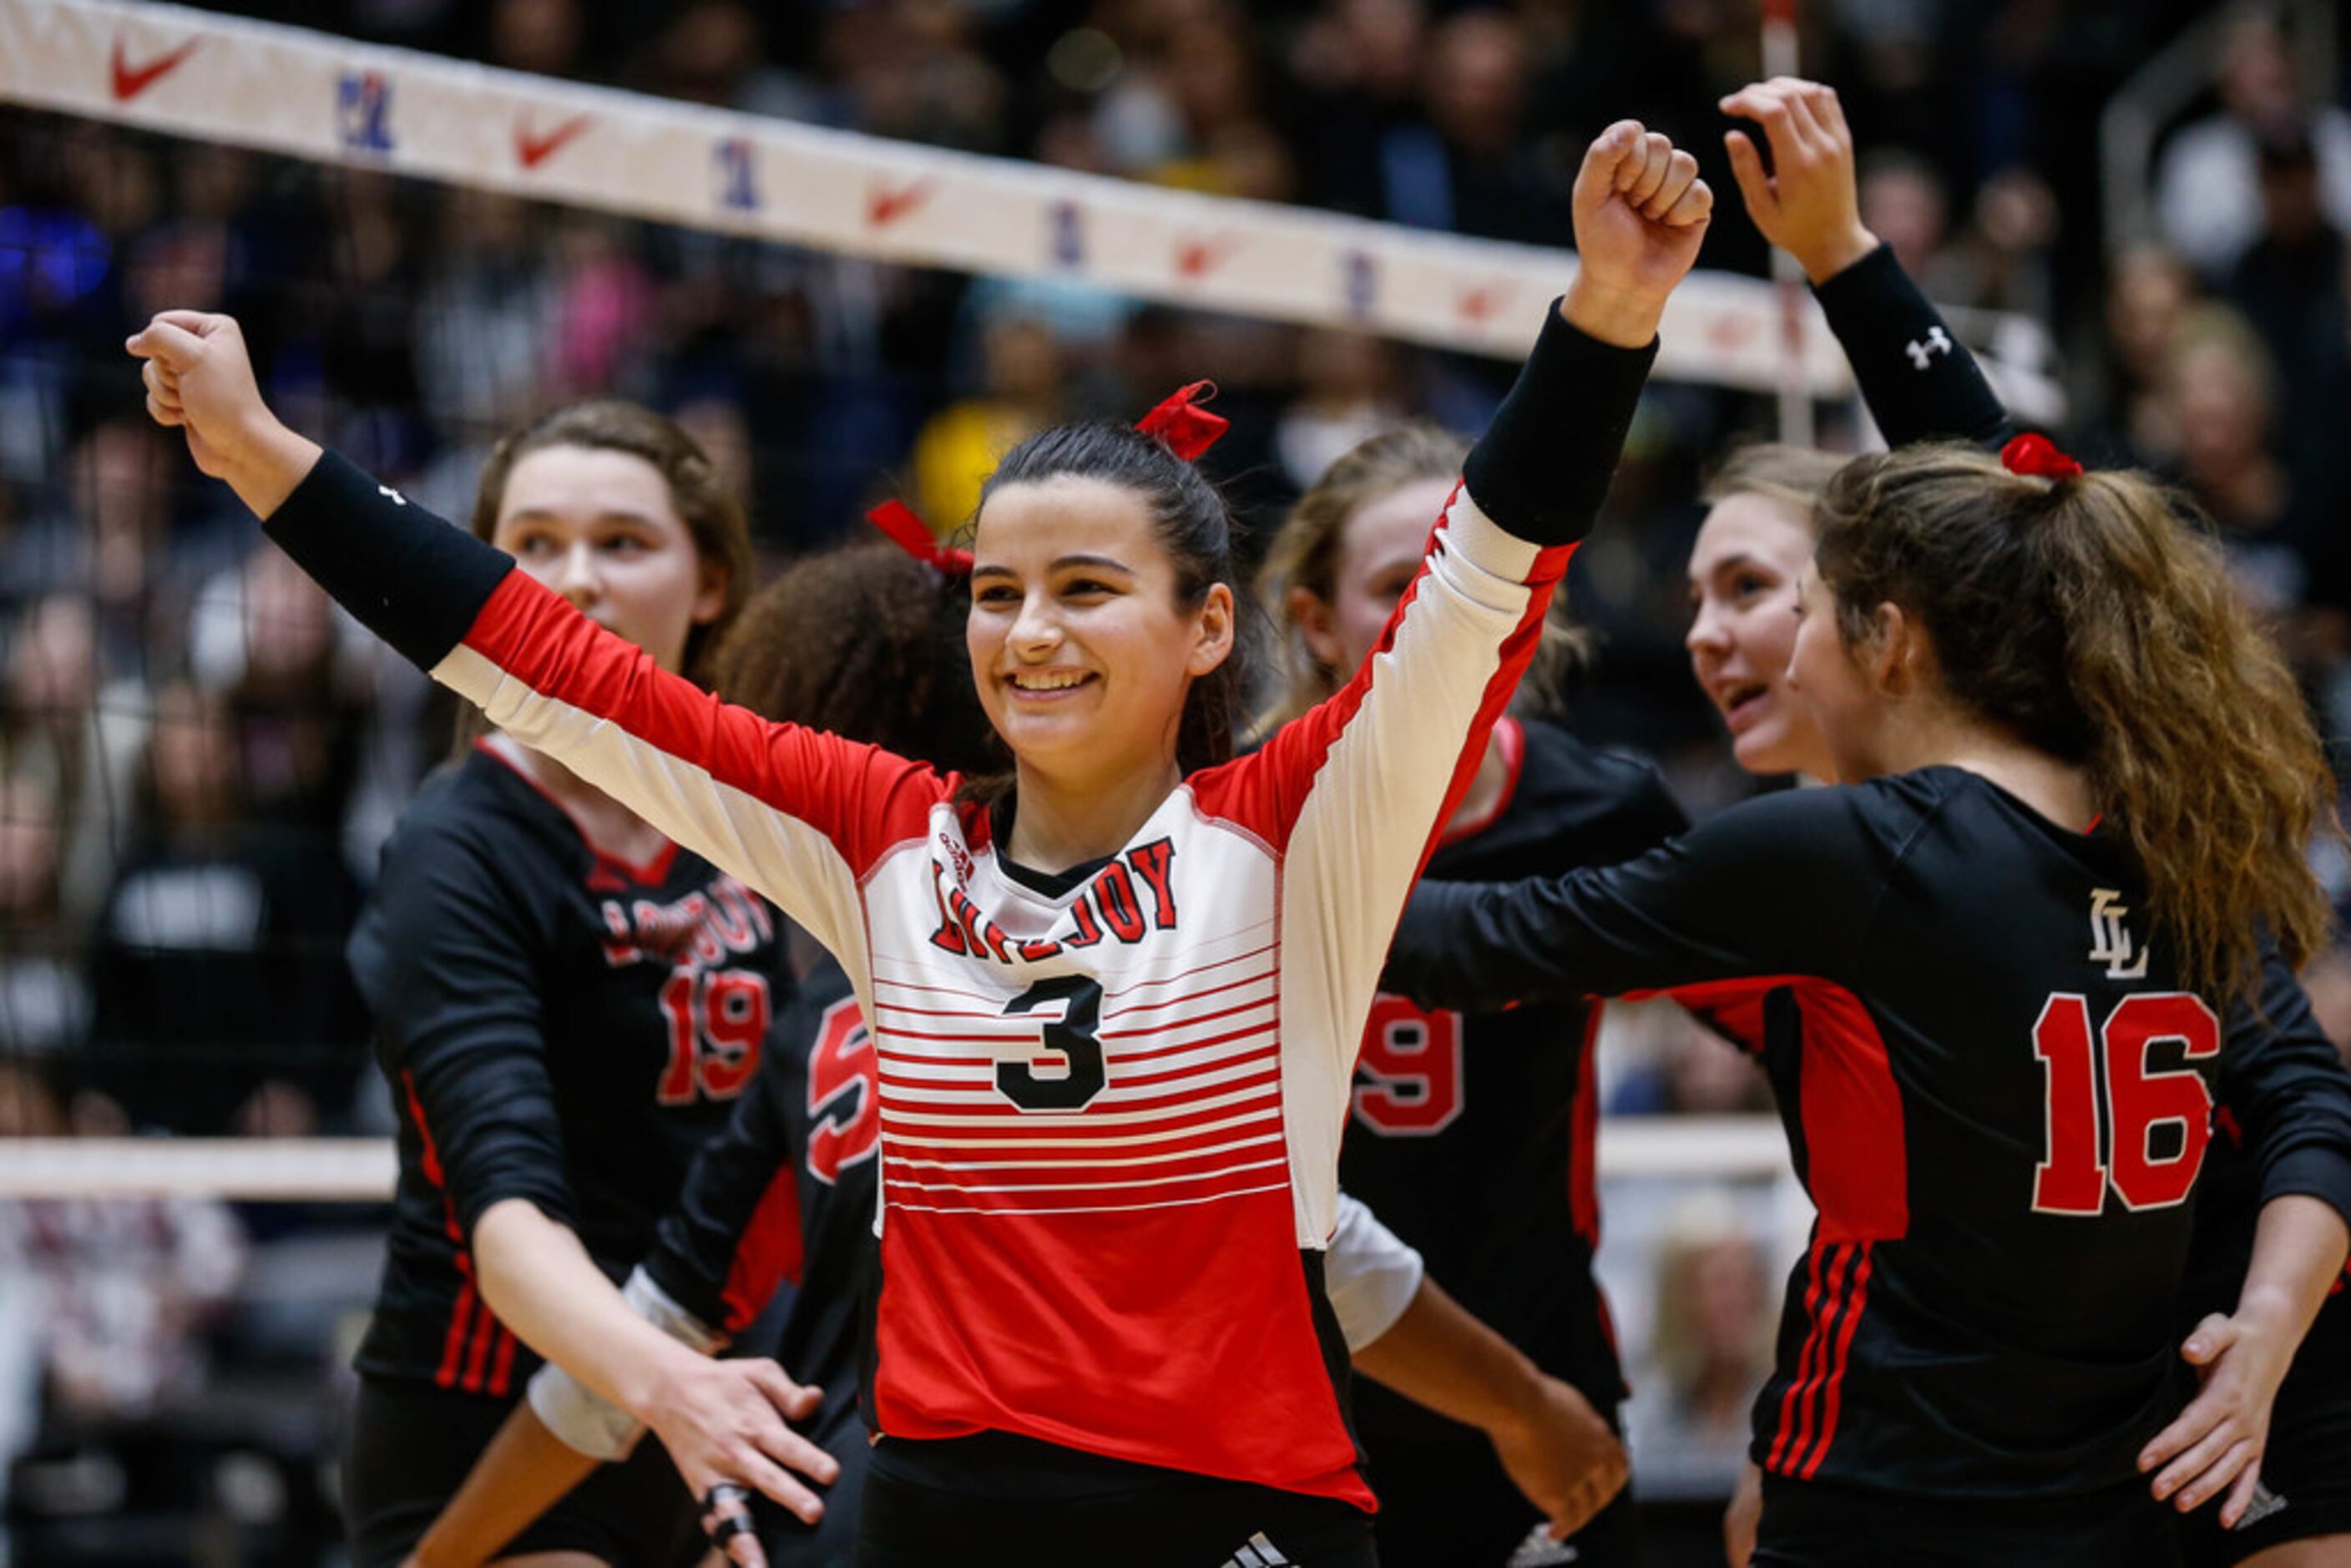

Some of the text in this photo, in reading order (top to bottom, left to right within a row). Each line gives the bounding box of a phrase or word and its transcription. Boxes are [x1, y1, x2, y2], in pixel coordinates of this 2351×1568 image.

[655, 965, 772, 1107] 19
[806, 994, 881, 1186] 5
[992, 972, 1108, 1112] 3
[2030, 991, 2221, 1216] 16
